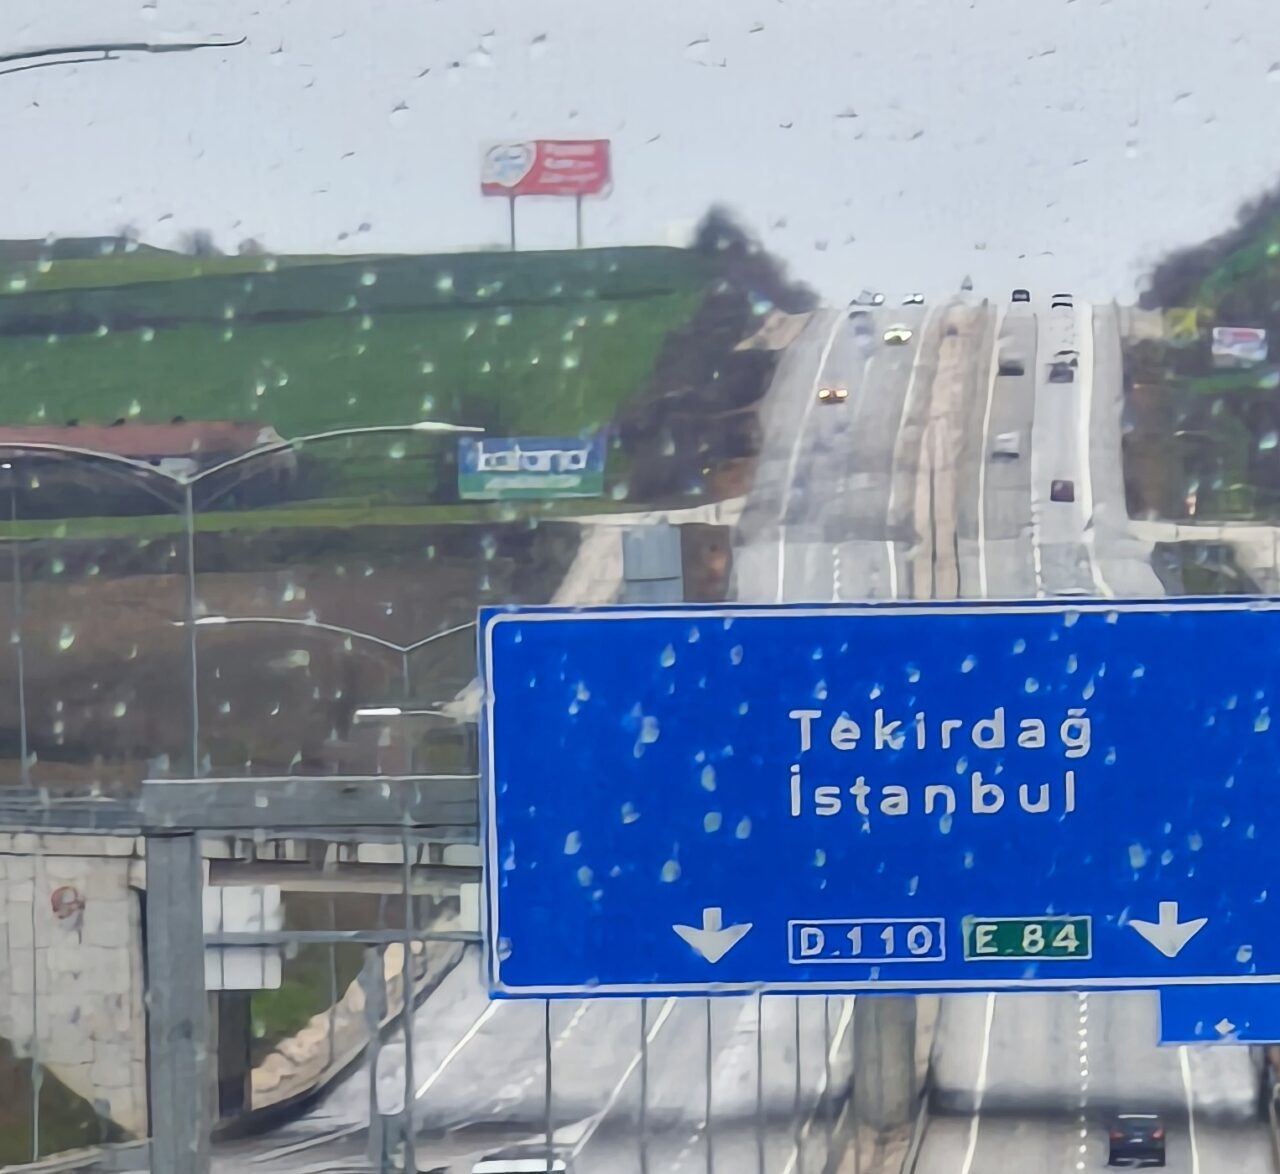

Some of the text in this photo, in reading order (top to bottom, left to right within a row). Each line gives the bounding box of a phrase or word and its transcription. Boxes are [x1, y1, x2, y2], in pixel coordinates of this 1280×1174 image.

[789, 706, 1092, 758] Tekirdağ
[790, 764, 1076, 816] İstanbul
[800, 925, 933, 956] D.110
